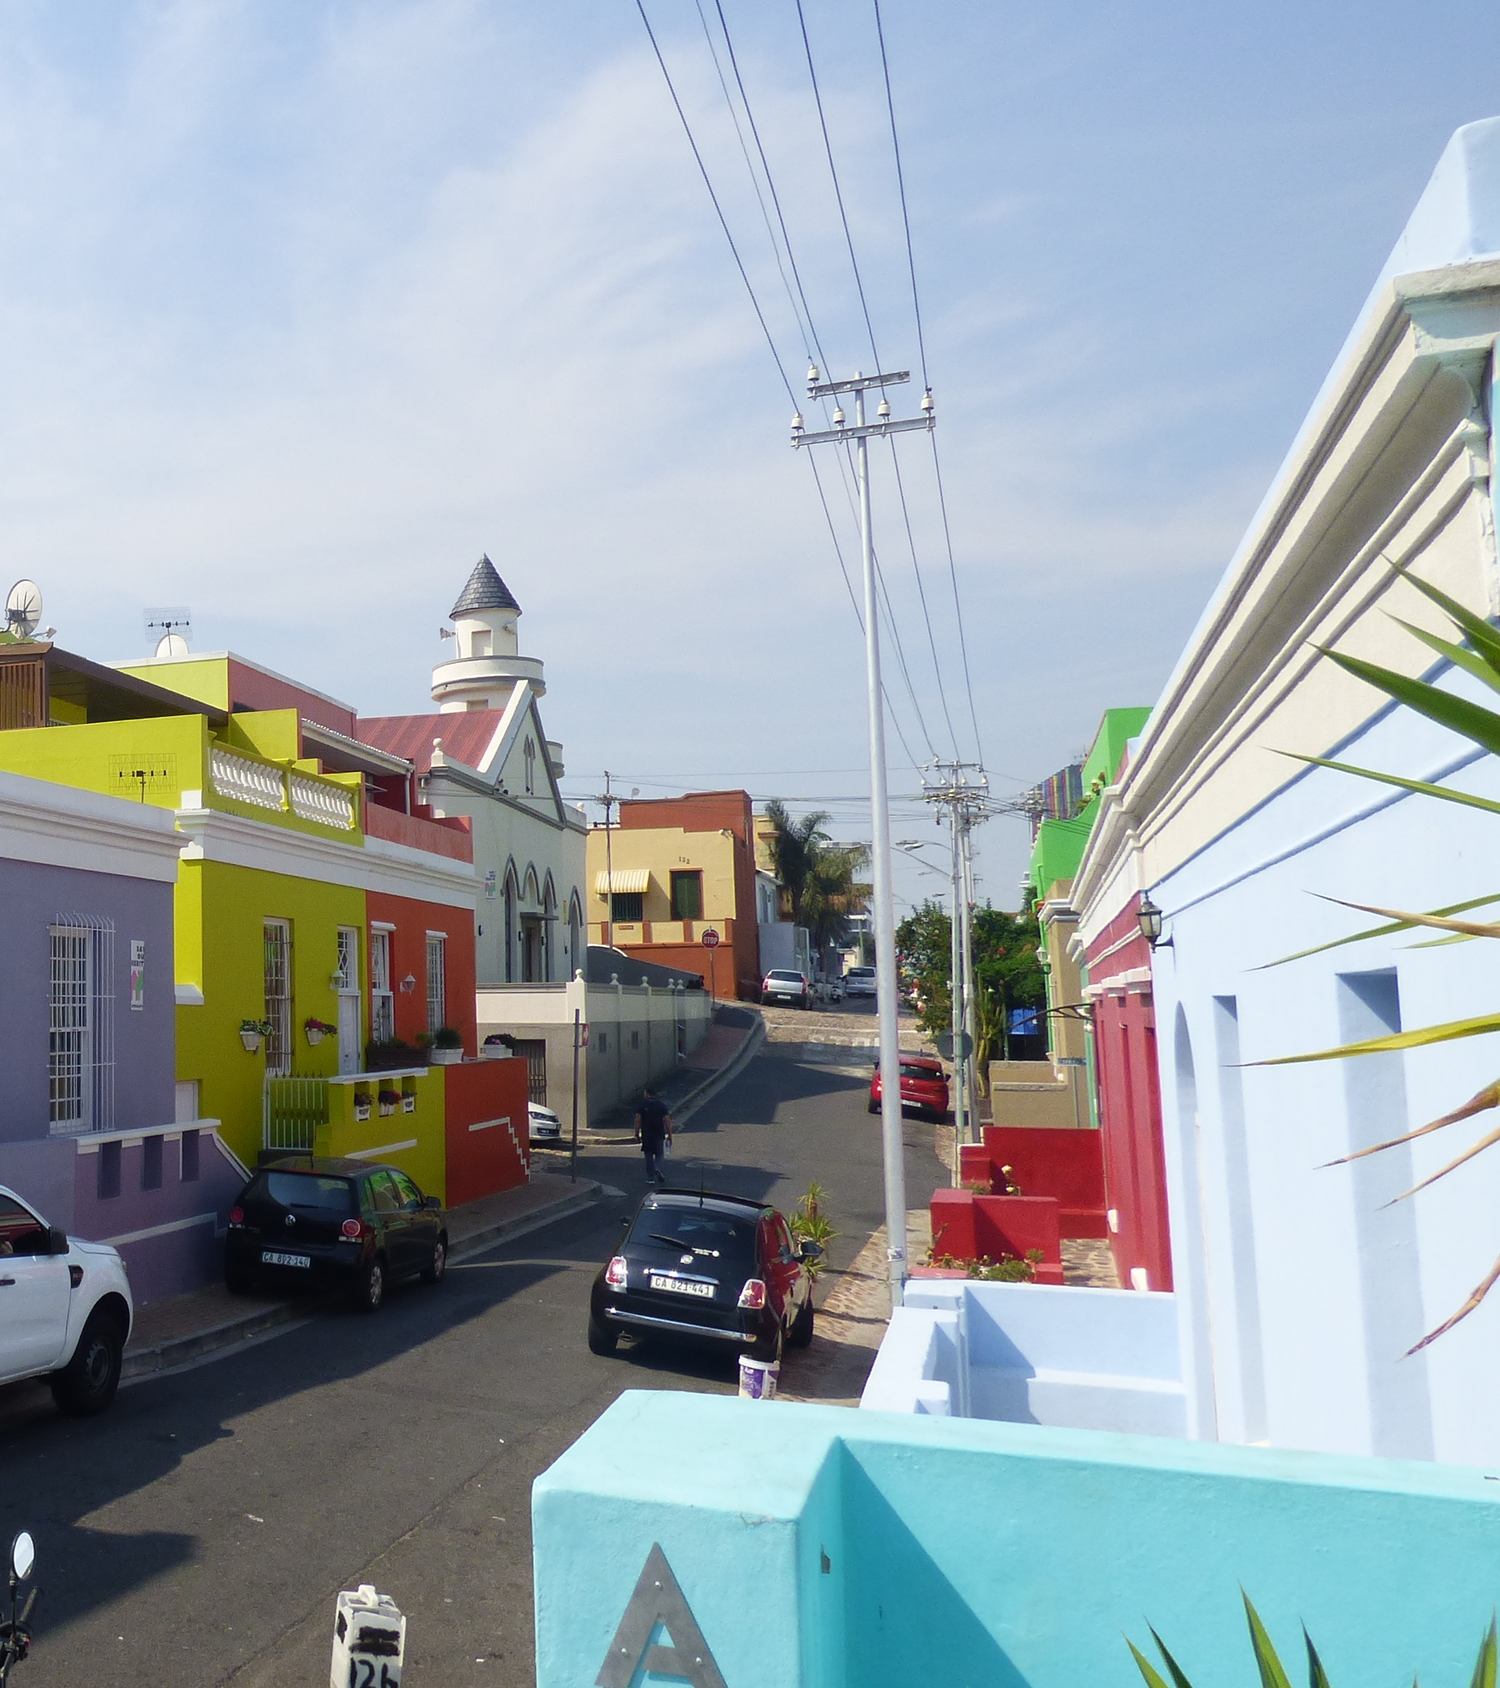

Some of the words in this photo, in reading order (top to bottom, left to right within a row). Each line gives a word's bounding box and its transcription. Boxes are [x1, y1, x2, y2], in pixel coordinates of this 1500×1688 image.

[702, 936, 718, 945] STOP
[655, 1277, 667, 1288] CA
[594, 1541, 729, 1688] A
